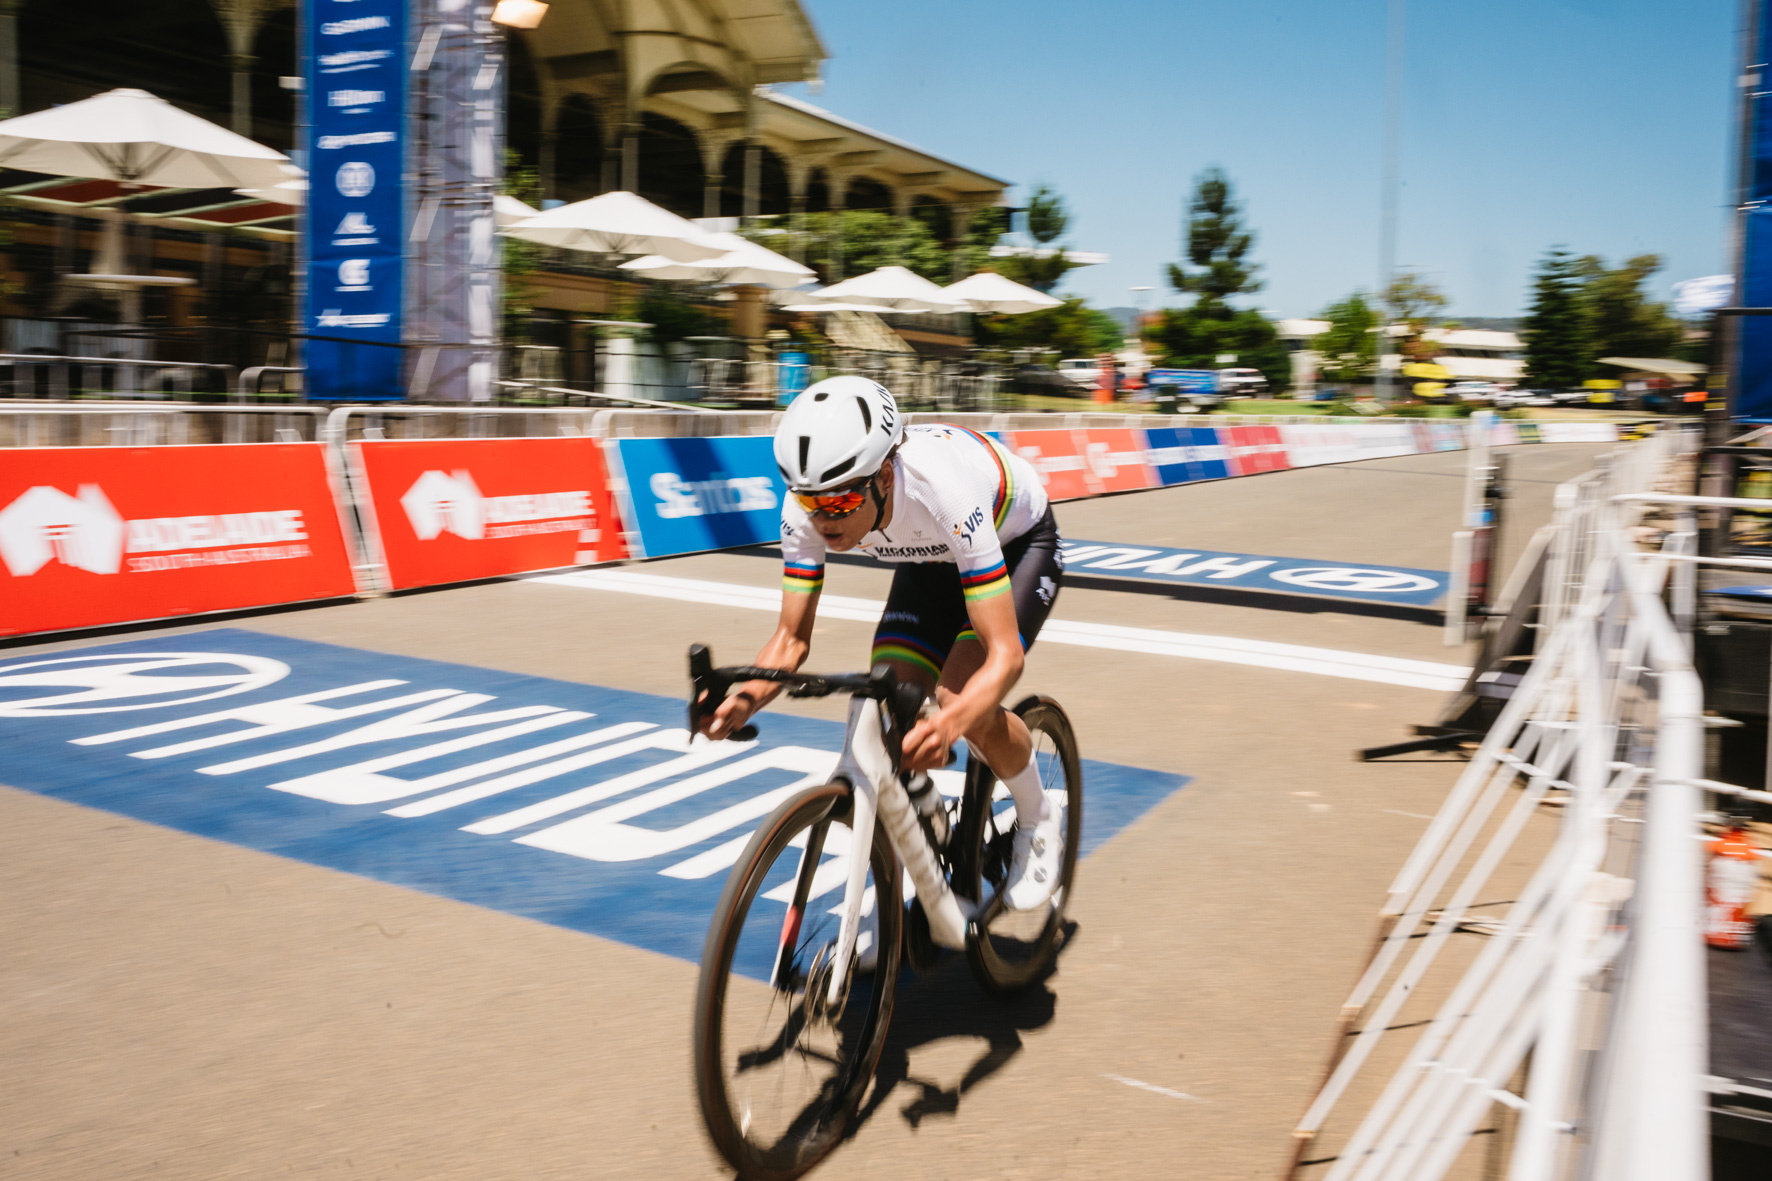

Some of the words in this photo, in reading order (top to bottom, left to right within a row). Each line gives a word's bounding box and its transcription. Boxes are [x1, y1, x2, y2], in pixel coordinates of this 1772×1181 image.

[873, 383, 894, 437] KA
[124, 509, 310, 553] ADELAIDE
[964, 506, 984, 533] VIS
[874, 543, 950, 555] VICTORIAN
